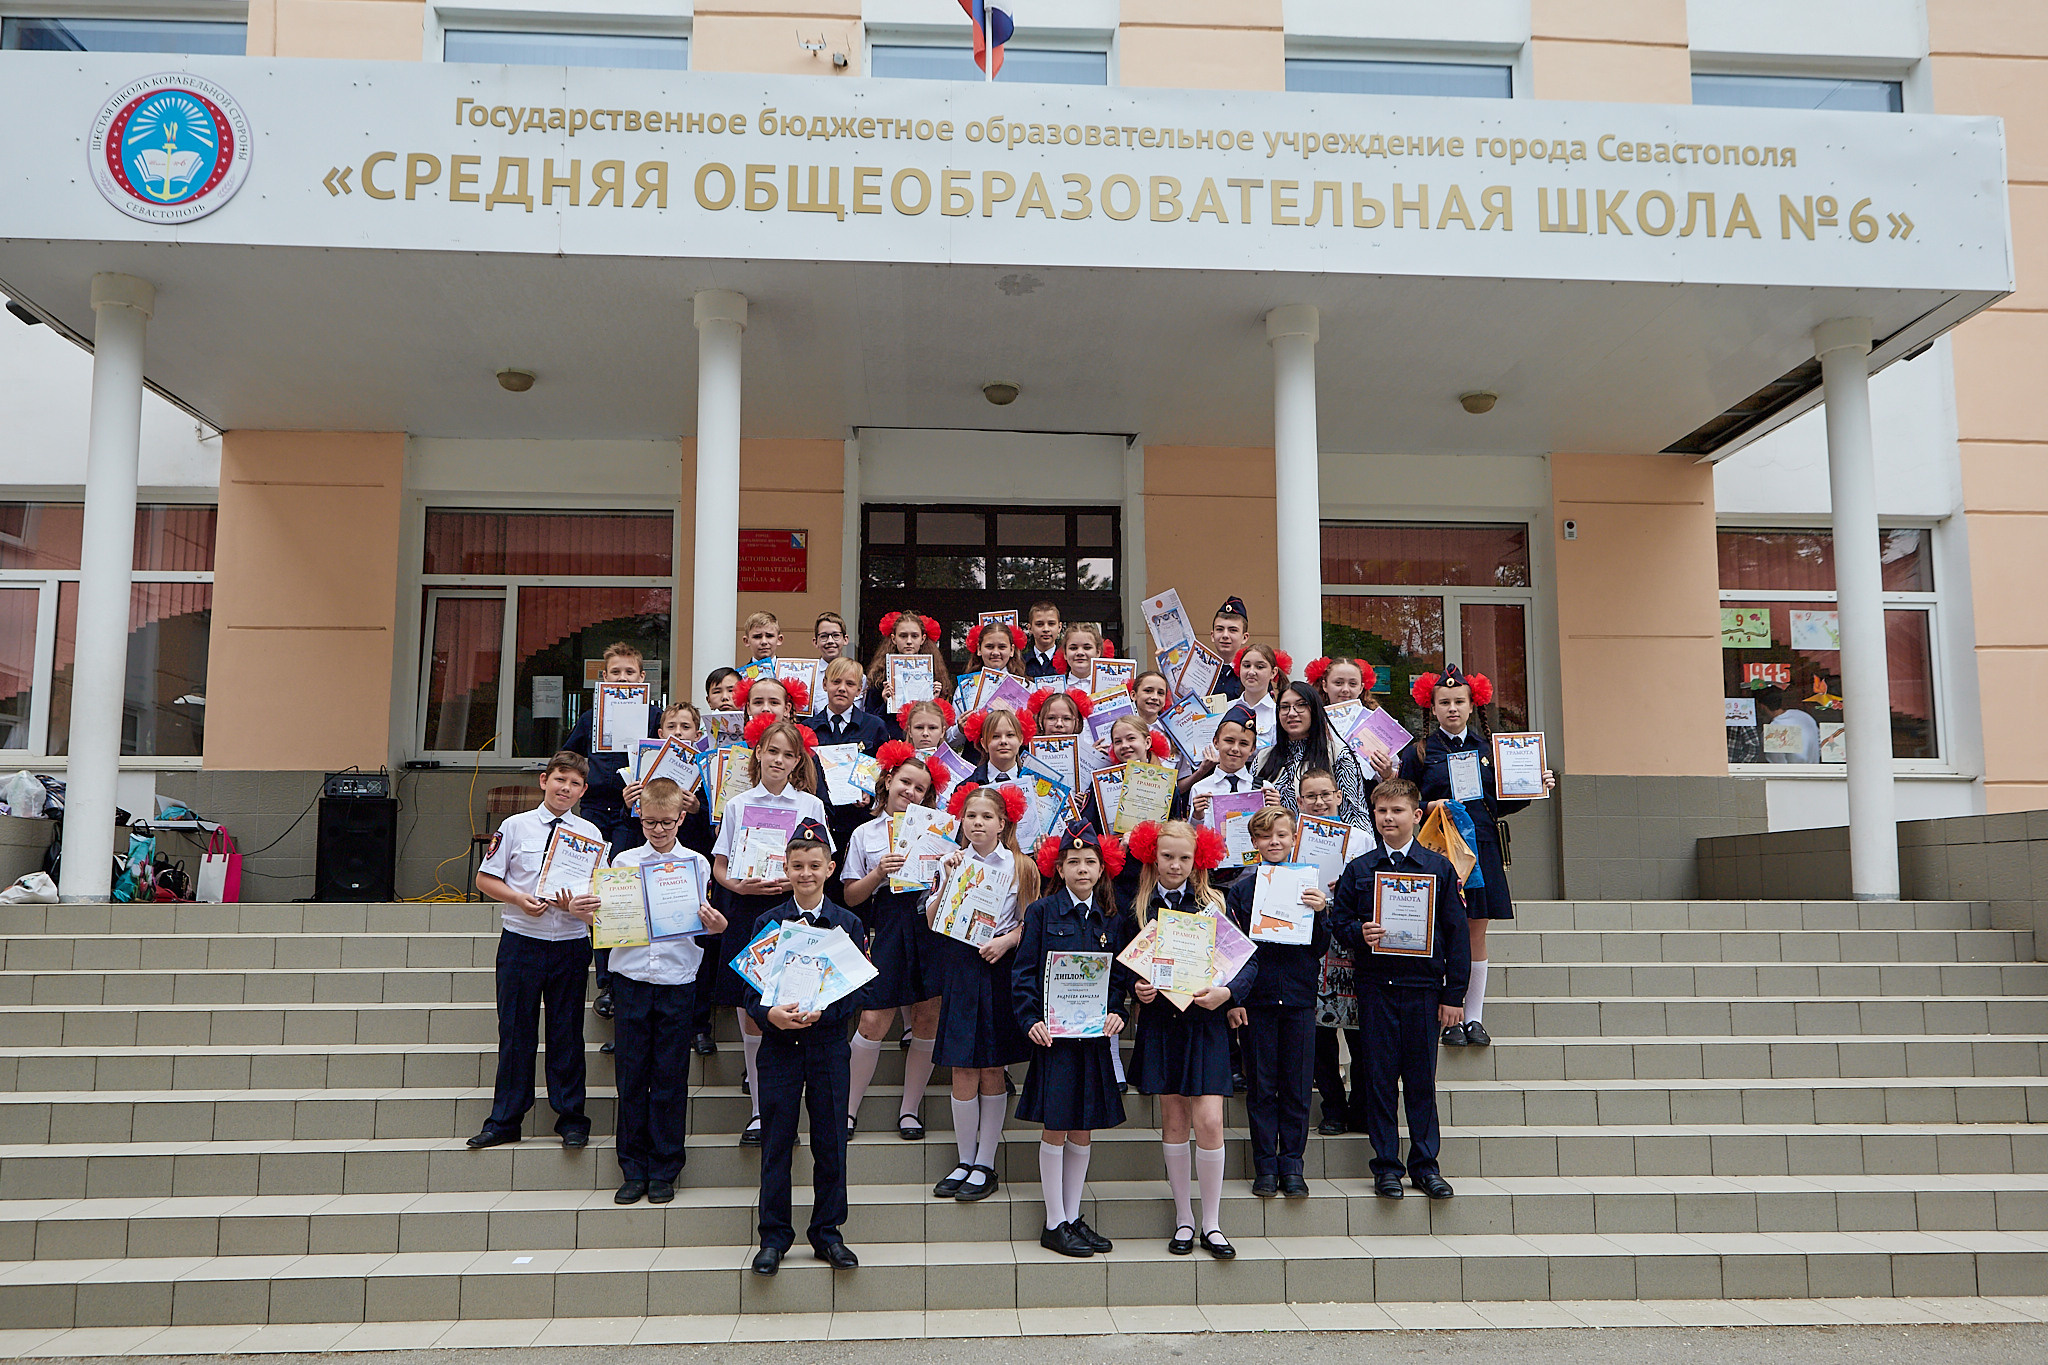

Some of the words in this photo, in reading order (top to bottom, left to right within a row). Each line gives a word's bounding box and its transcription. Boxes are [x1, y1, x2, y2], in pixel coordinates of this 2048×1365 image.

[92, 108, 114, 151] ШЕСТАЯ
[111, 80, 150, 108] ШКОЛА
[152, 75, 233, 109] КОРАБЕЛЬНОЙ
[229, 108, 248, 161] СТОРОНЫ
[455, 97, 748, 137] Государственное
[758, 108, 955, 142] бюджетное
[965, 116, 1254, 150] образовательное
[1265, 130, 1464, 159] учреждение
[1475, 136, 1588, 165] города
[1597, 134, 1798, 168] Севастополя
[322, 151, 669, 213] «СРЕДНЯЯ
[694, 162, 1513, 232] ОБЩЕОБРАЗОВАТЕЛЬНАЯ
[1538, 187, 1762, 240] ШКОЛА
[126, 202, 206, 219] СЕВАСТОПОЛЬ
[1735, 614, 1744, 626] 9
[1743, 663, 1791, 683] 1945
[668, 757, 693, 775] ГРАМОТА
[1106, 785, 1122, 793] ГРАМ
[1137, 780, 1161, 789] ГРАМОТА
[1308, 836, 1337, 848] ГРАМОТА
[561, 849, 589, 863] ГРАМОТА
[659, 879, 688, 887] ГРАМОТА
[1172, 931, 1200, 940] ГРАМОТА
